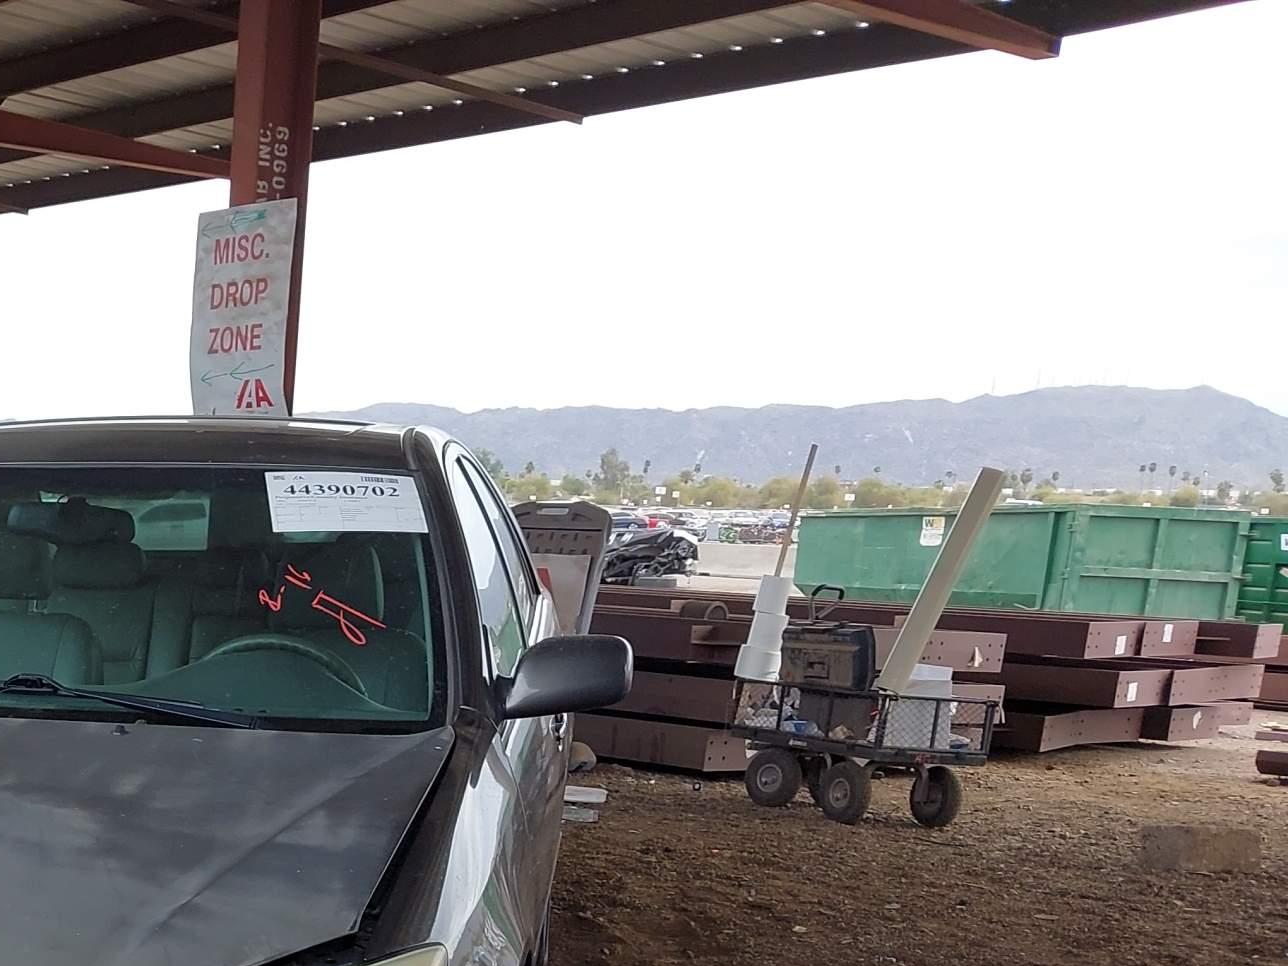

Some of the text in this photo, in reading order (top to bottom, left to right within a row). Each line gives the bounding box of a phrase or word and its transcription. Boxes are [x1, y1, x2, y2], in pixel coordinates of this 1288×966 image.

[257, 122, 273, 167] INC.
[213, 232, 270, 266] MISC.
[210, 277, 269, 310] DROP
[207, 323, 264, 355] ZONE
[283, 484, 400, 497] 44390702
